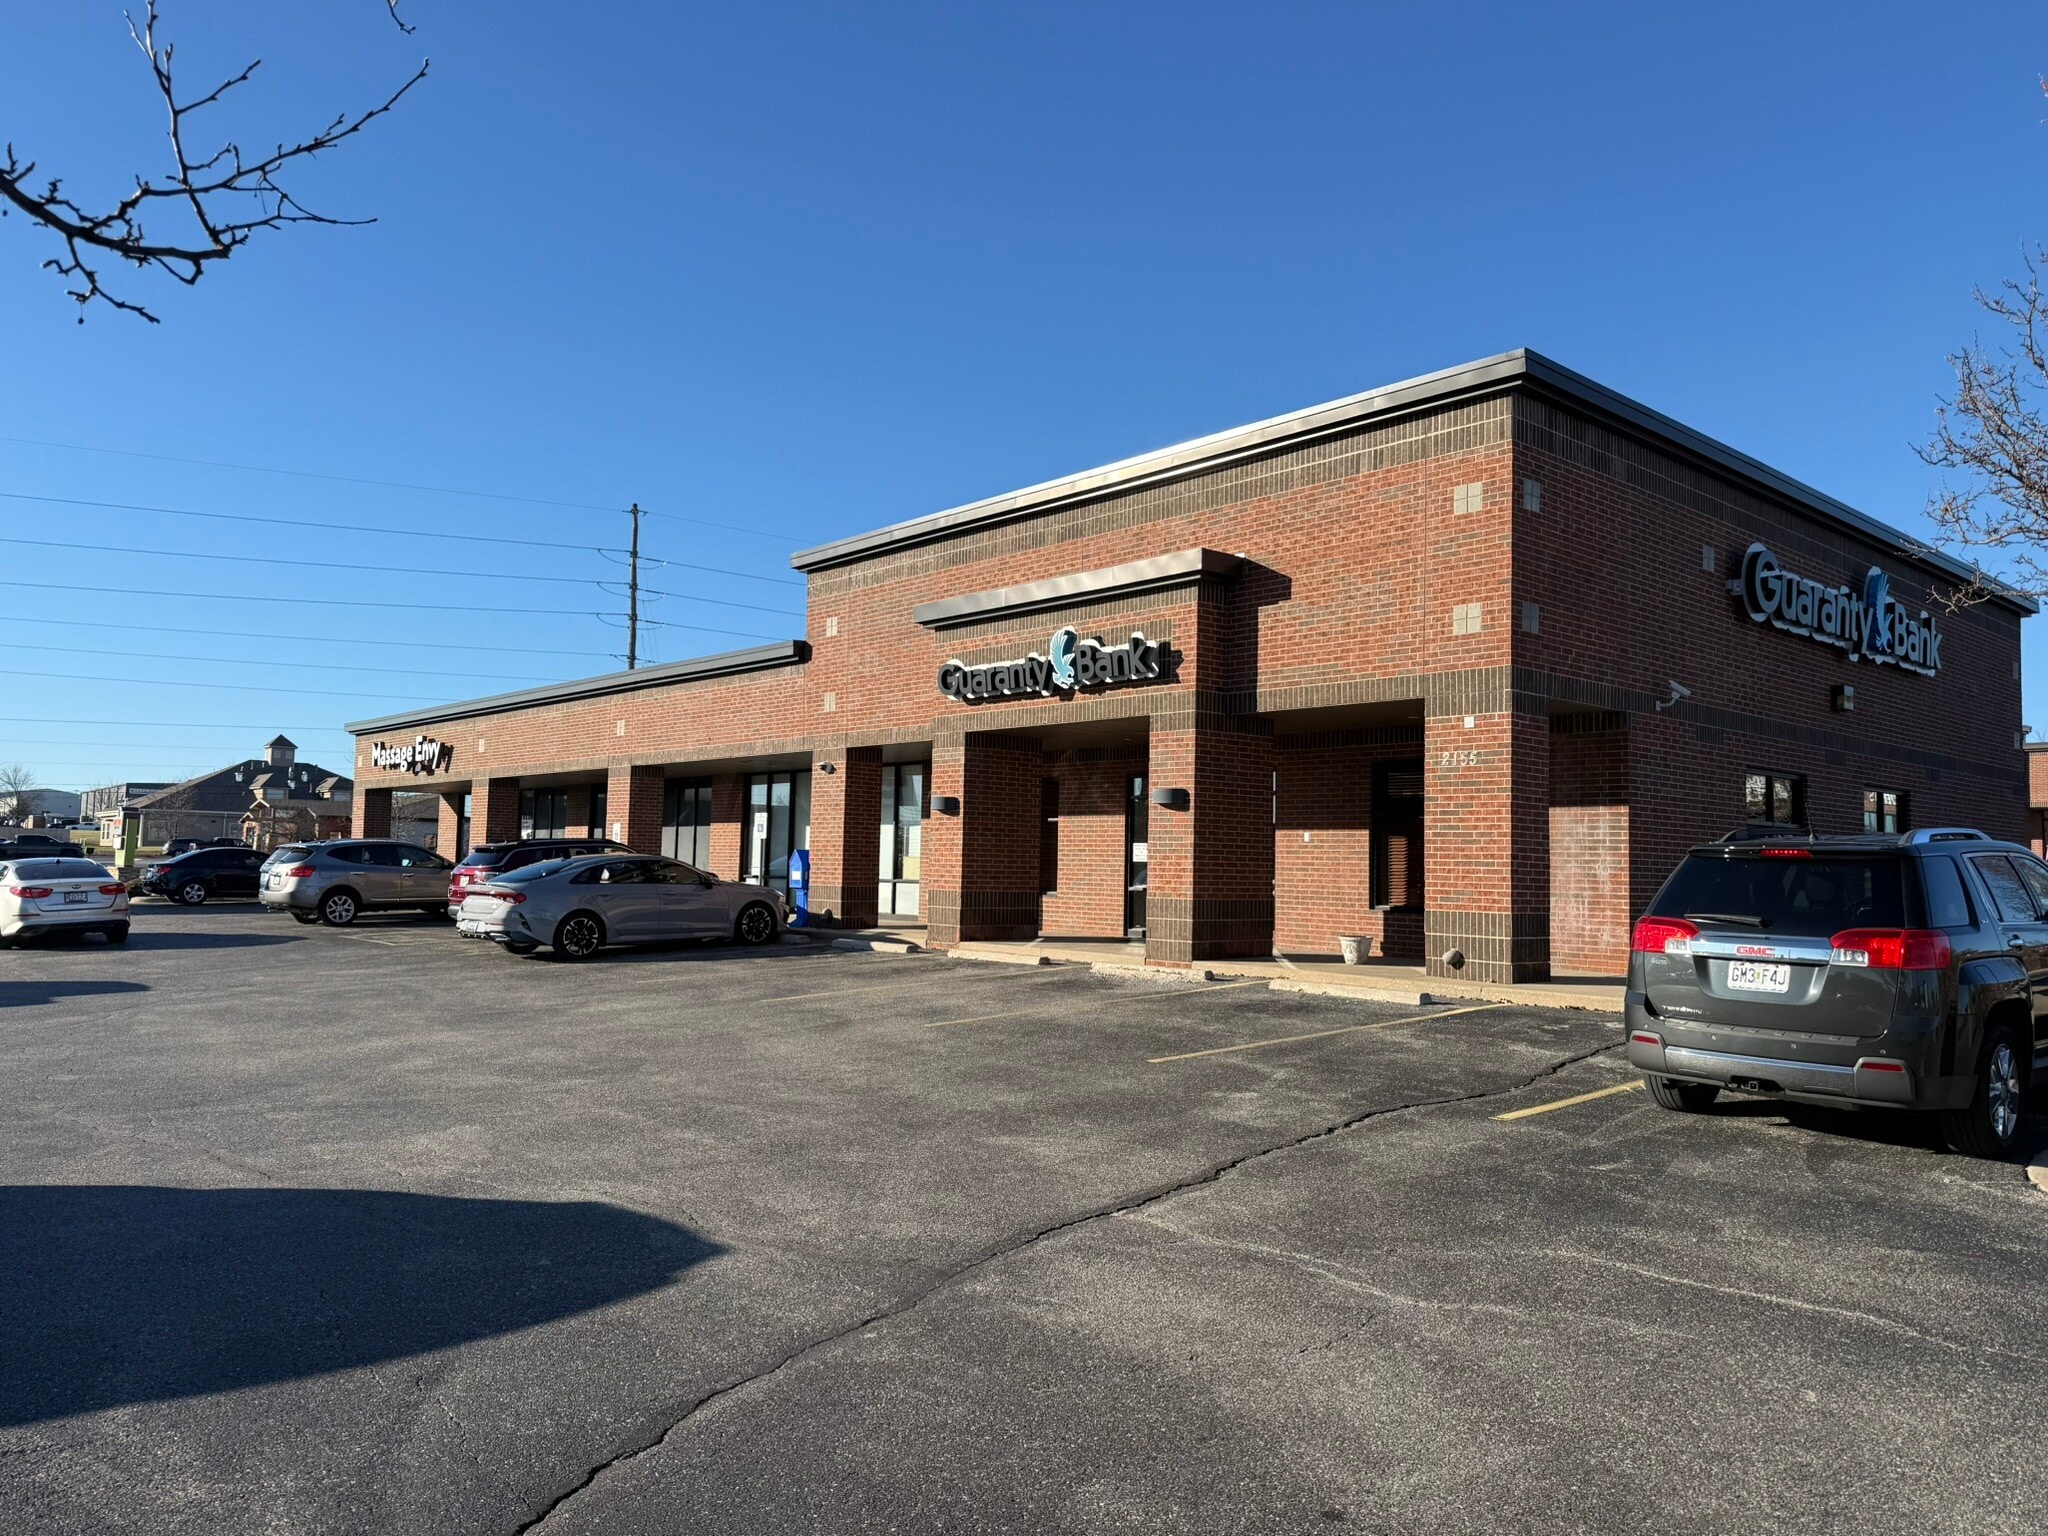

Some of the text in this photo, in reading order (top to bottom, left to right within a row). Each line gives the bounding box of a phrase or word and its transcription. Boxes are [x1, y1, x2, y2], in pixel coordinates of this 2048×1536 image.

[1751, 549, 1943, 670] Guaranty Bank
[938, 635, 1151, 696] Guaranty Bank
[371, 735, 441, 773] Massage Envy
[1441, 751, 1478, 767] 2155
[1736, 945, 1776, 957] GMC
